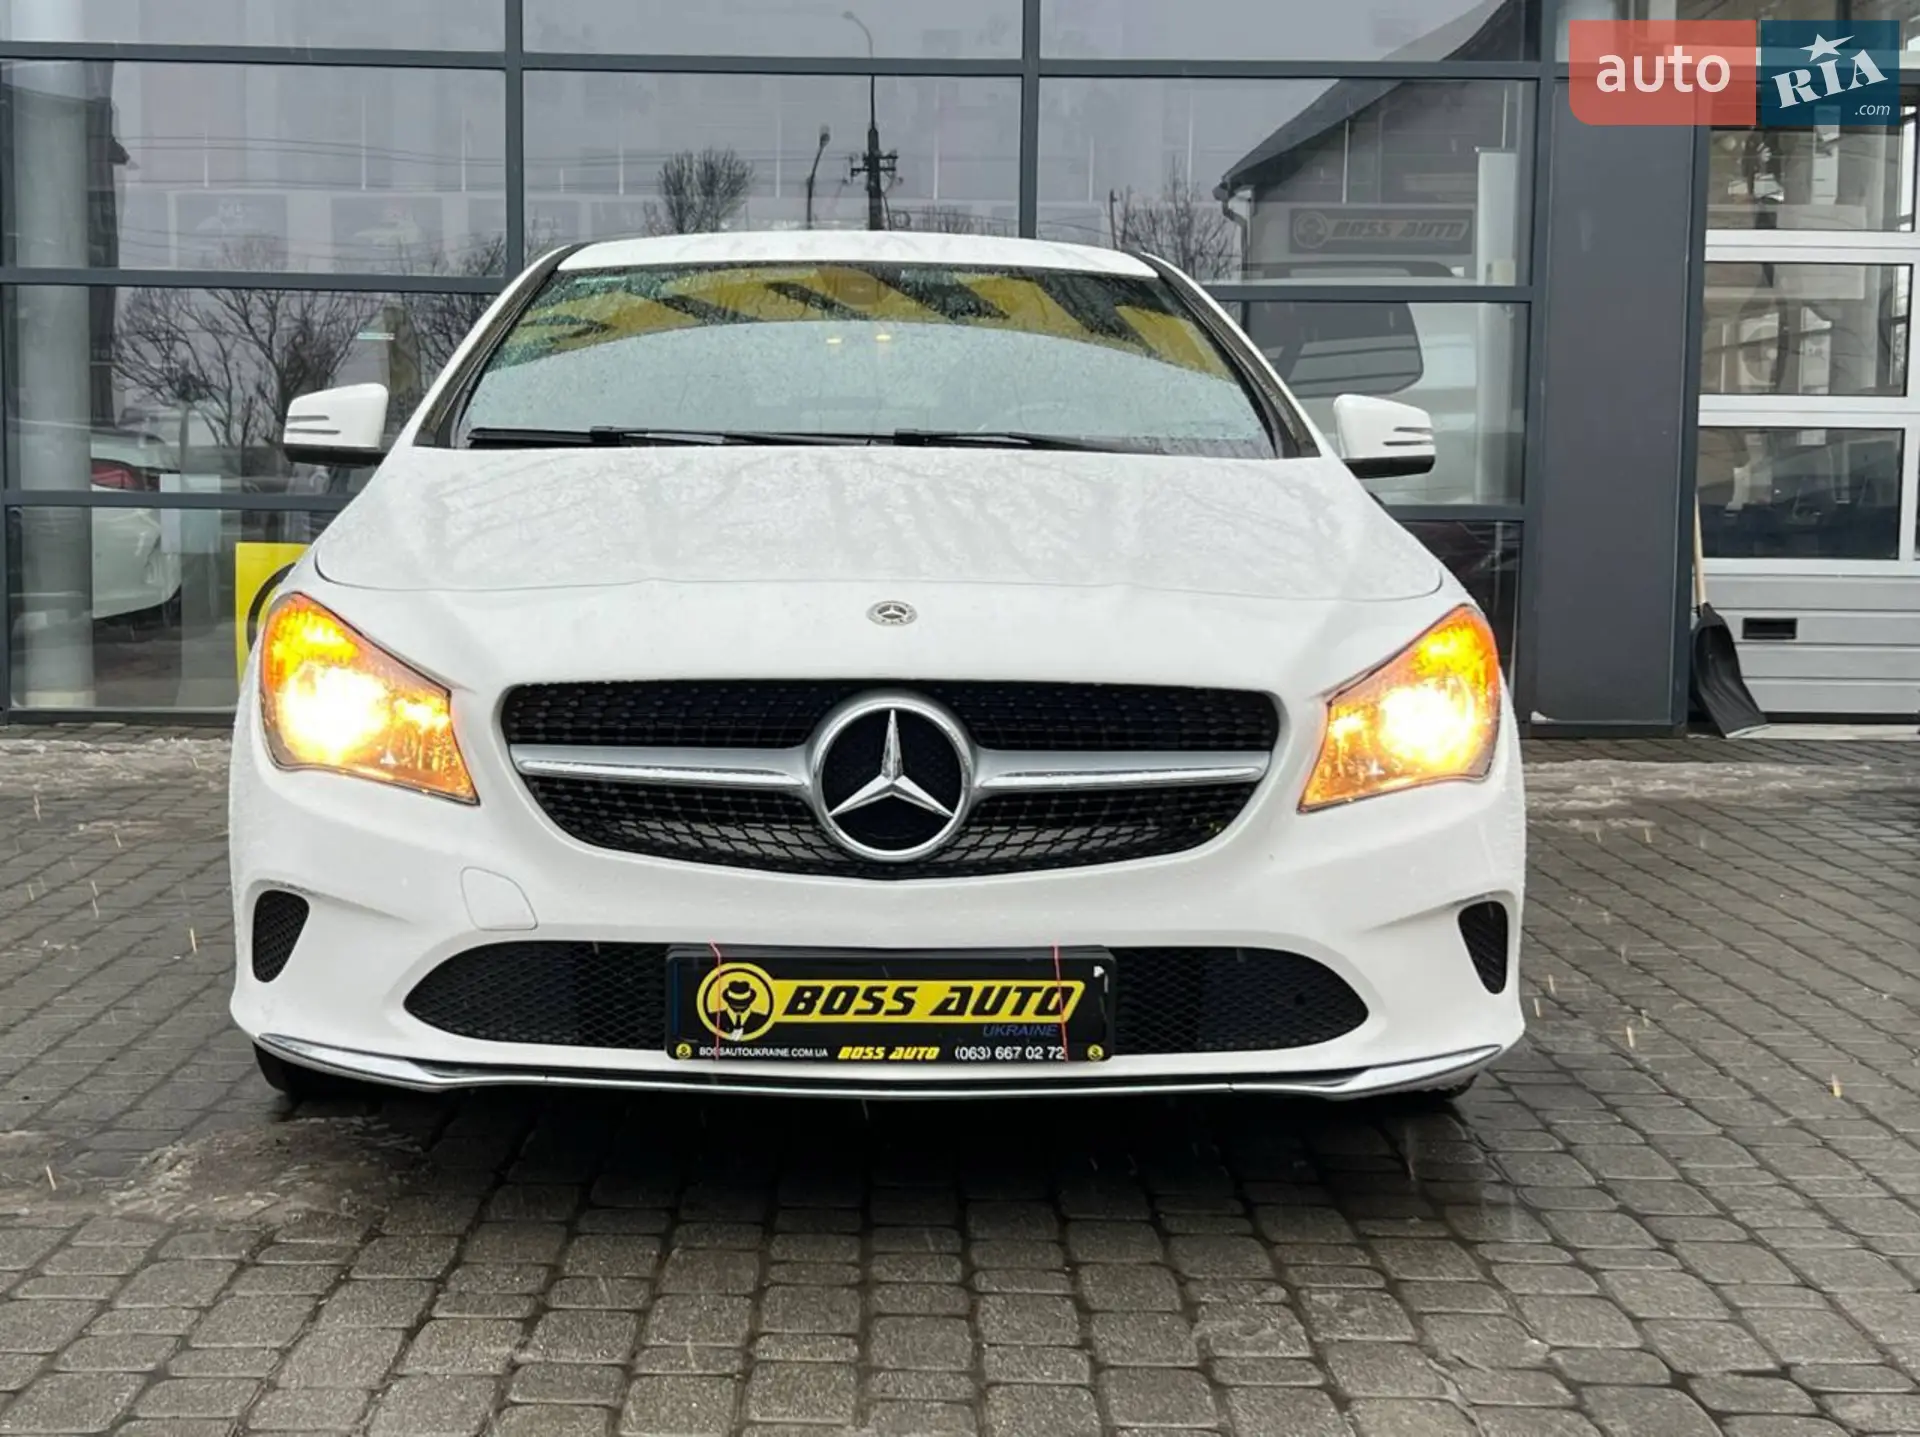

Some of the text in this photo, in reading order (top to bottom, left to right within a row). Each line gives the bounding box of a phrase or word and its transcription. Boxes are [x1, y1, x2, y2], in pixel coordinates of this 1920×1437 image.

[782, 985, 1076, 1016] BOSS AUTO
[983, 1024, 1059, 1038] UKRAINE
[838, 1046, 941, 1060] BOSS AUTO
[955, 1046, 1066, 1061] (063) 667 02 72
